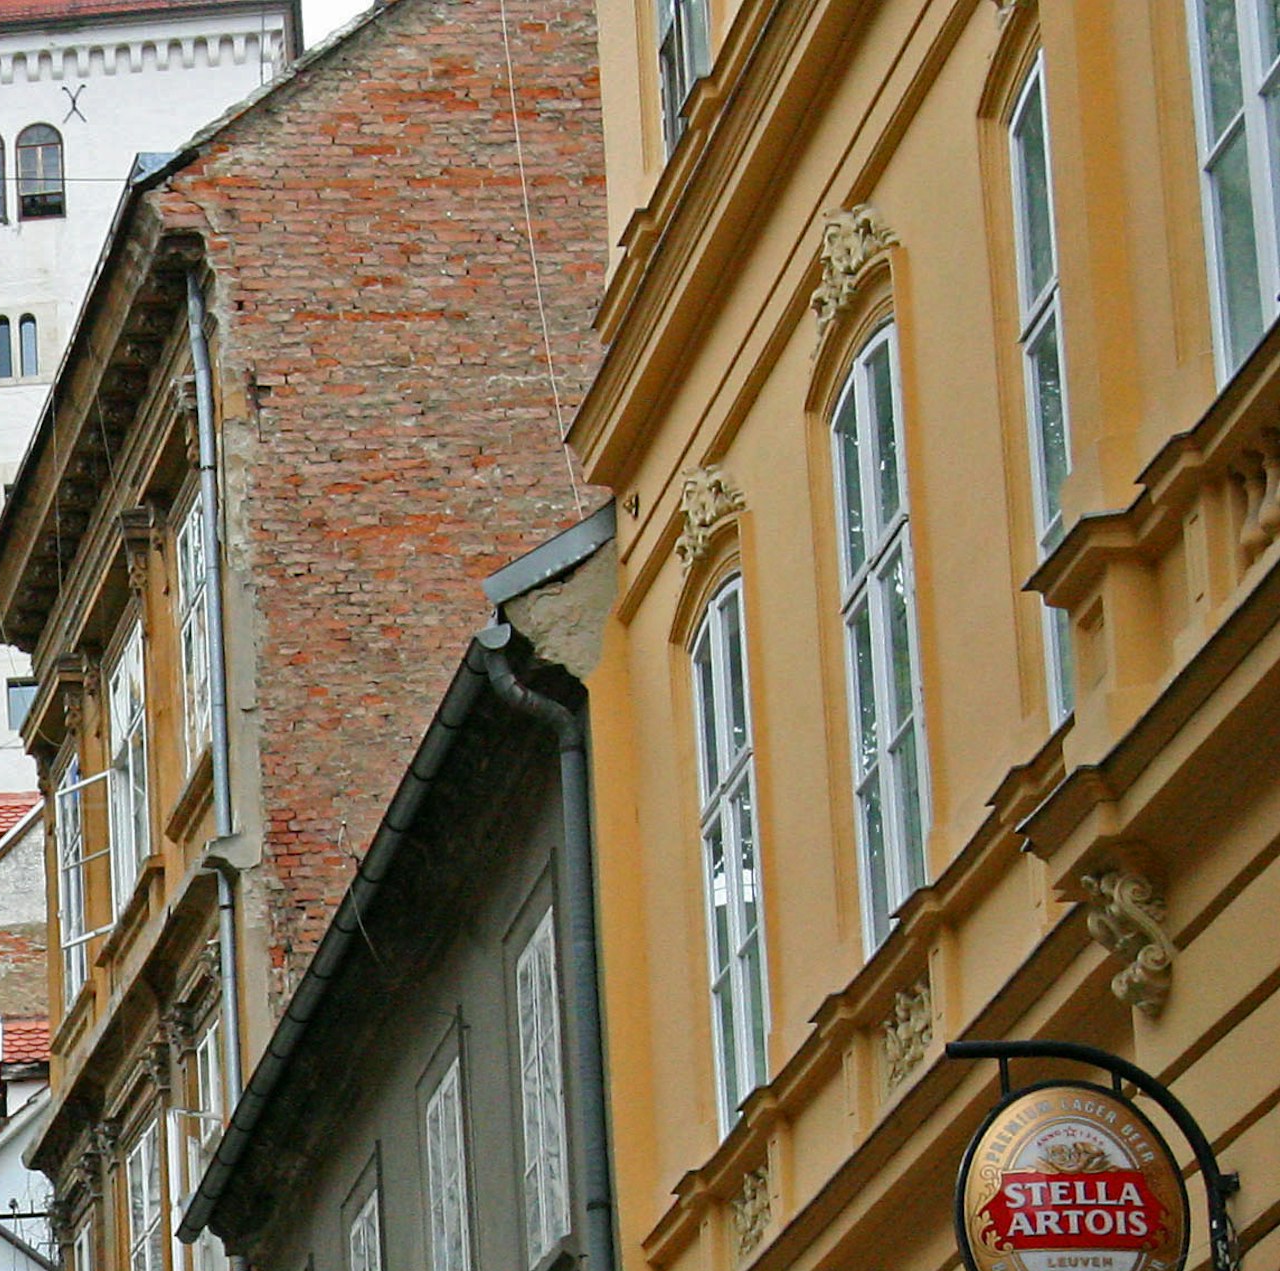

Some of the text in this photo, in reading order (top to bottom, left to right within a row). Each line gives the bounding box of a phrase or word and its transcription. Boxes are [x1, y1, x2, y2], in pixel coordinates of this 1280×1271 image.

[1060, 1099, 1117, 1124] LAGER
[1121, 1123, 1155, 1163] BEER
[1003, 1181, 1145, 1208] STELLA
[1006, 1208, 1149, 1238] ARTOIS
